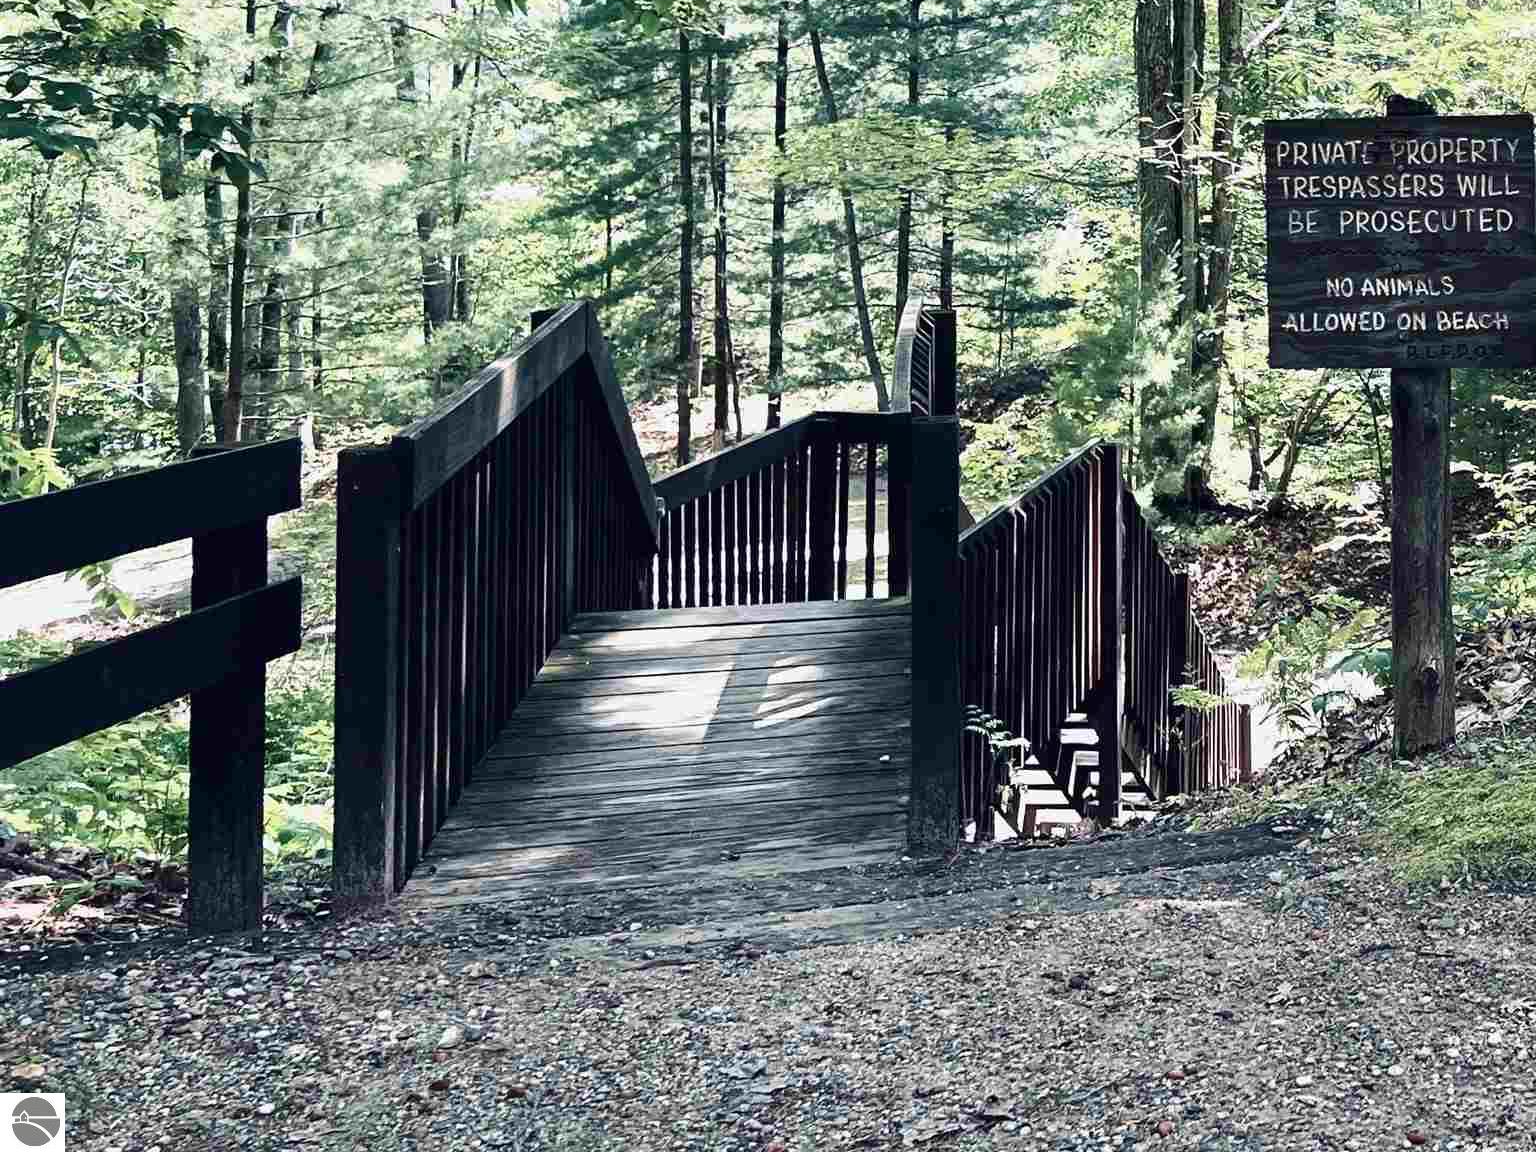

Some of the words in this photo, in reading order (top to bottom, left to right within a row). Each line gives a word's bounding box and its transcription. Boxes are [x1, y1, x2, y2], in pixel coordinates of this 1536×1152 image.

[1276, 138, 1376, 167] PRIVATE
[1391, 137, 1520, 166] PROPERTY
[1278, 174, 1445, 199] TRESPASSERS
[1457, 174, 1520, 197] WILL
[1288, 209, 1321, 234] BE
[1339, 208, 1514, 234] PROSECUTED
[1326, 277, 1353, 297] NO
[1361, 276, 1456, 297] ANIMALS
[1281, 311, 1386, 332] ALLOWED
[1396, 312, 1426, 331] ON
[1437, 311, 1510, 331] BEACH
